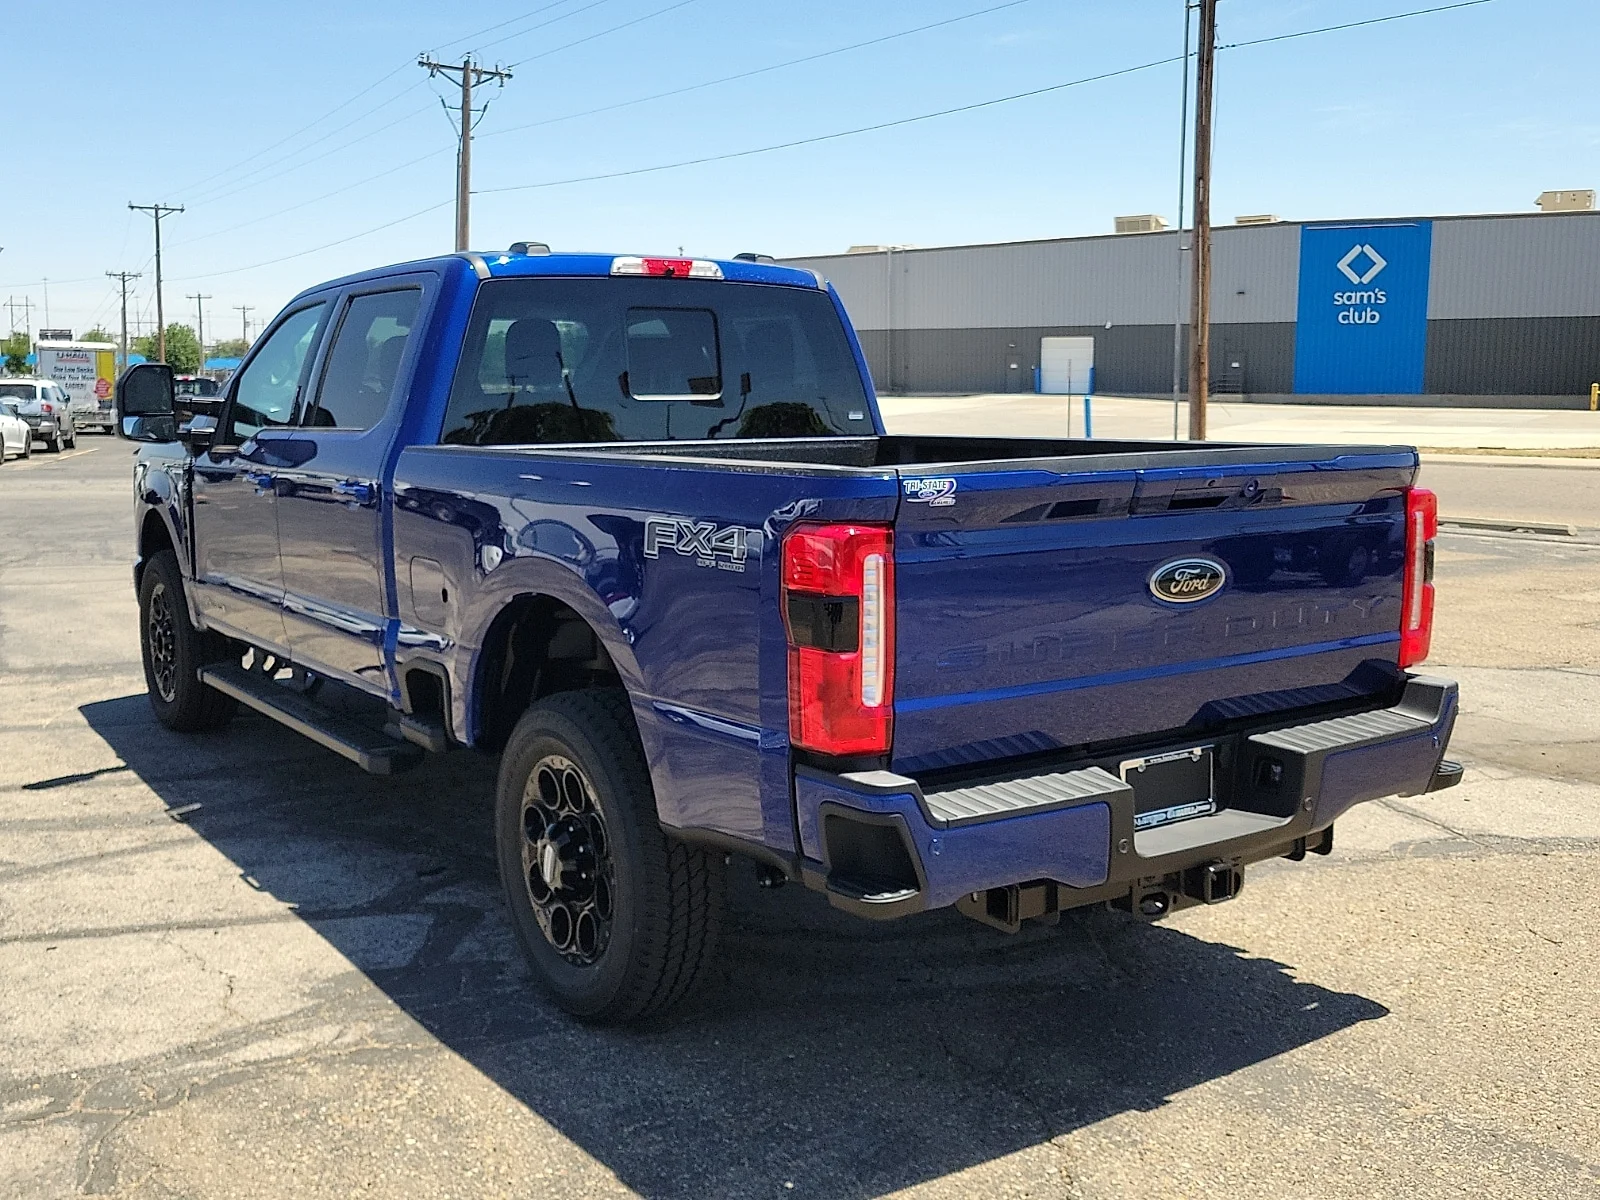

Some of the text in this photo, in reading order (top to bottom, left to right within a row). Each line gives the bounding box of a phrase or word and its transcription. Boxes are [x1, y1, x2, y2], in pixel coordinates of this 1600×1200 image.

[1333, 288, 1387, 305] sam's
[1338, 307, 1380, 324] club
[644, 517, 747, 563] FX4
[1170, 568, 1211, 594] Ford
